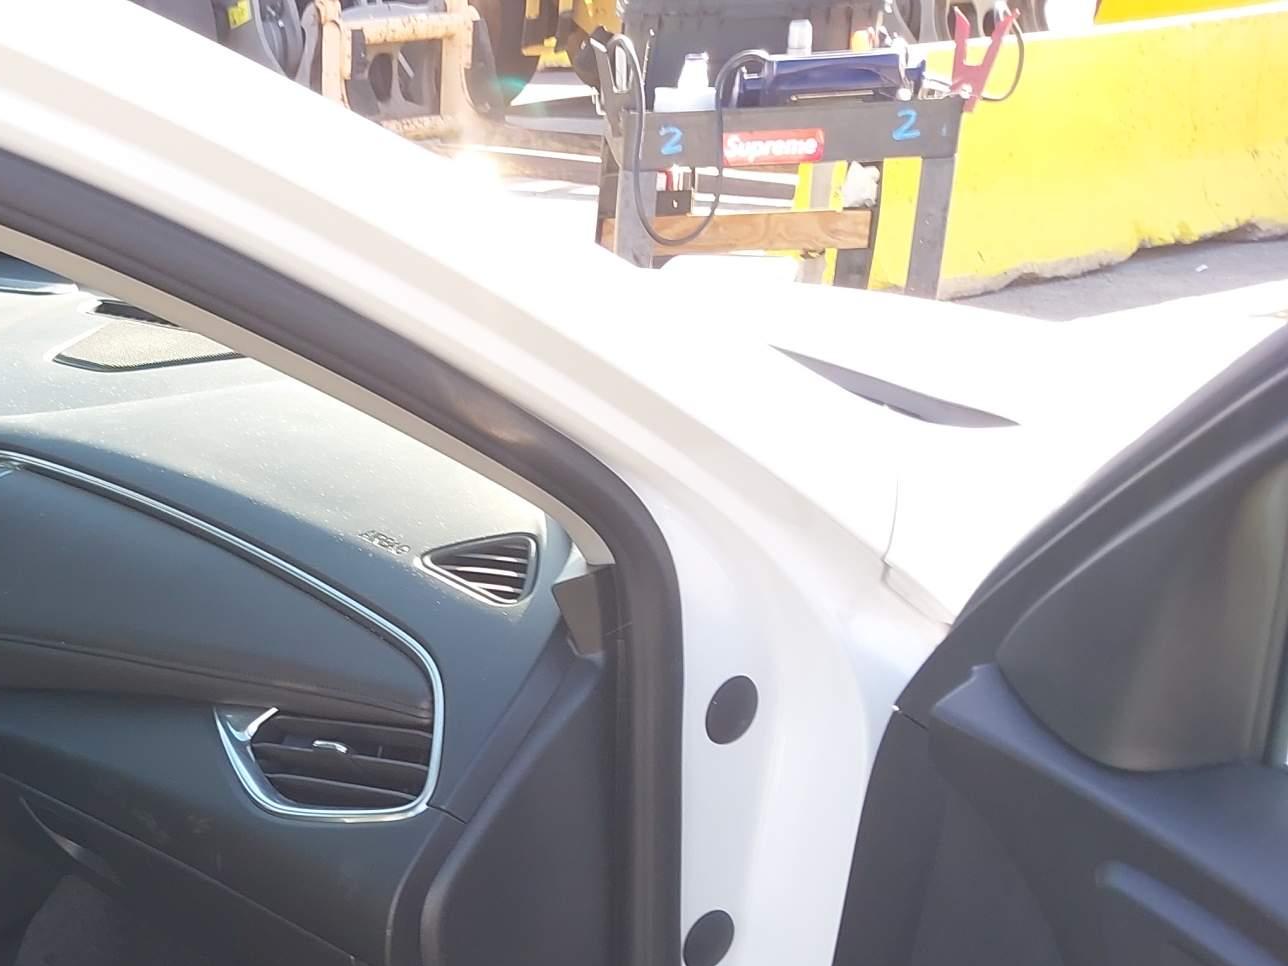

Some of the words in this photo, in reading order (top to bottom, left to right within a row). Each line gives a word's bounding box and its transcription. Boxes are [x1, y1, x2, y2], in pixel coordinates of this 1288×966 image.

[892, 109, 921, 141] 2
[659, 126, 684, 155] 2
[724, 133, 819, 163] Supreme
